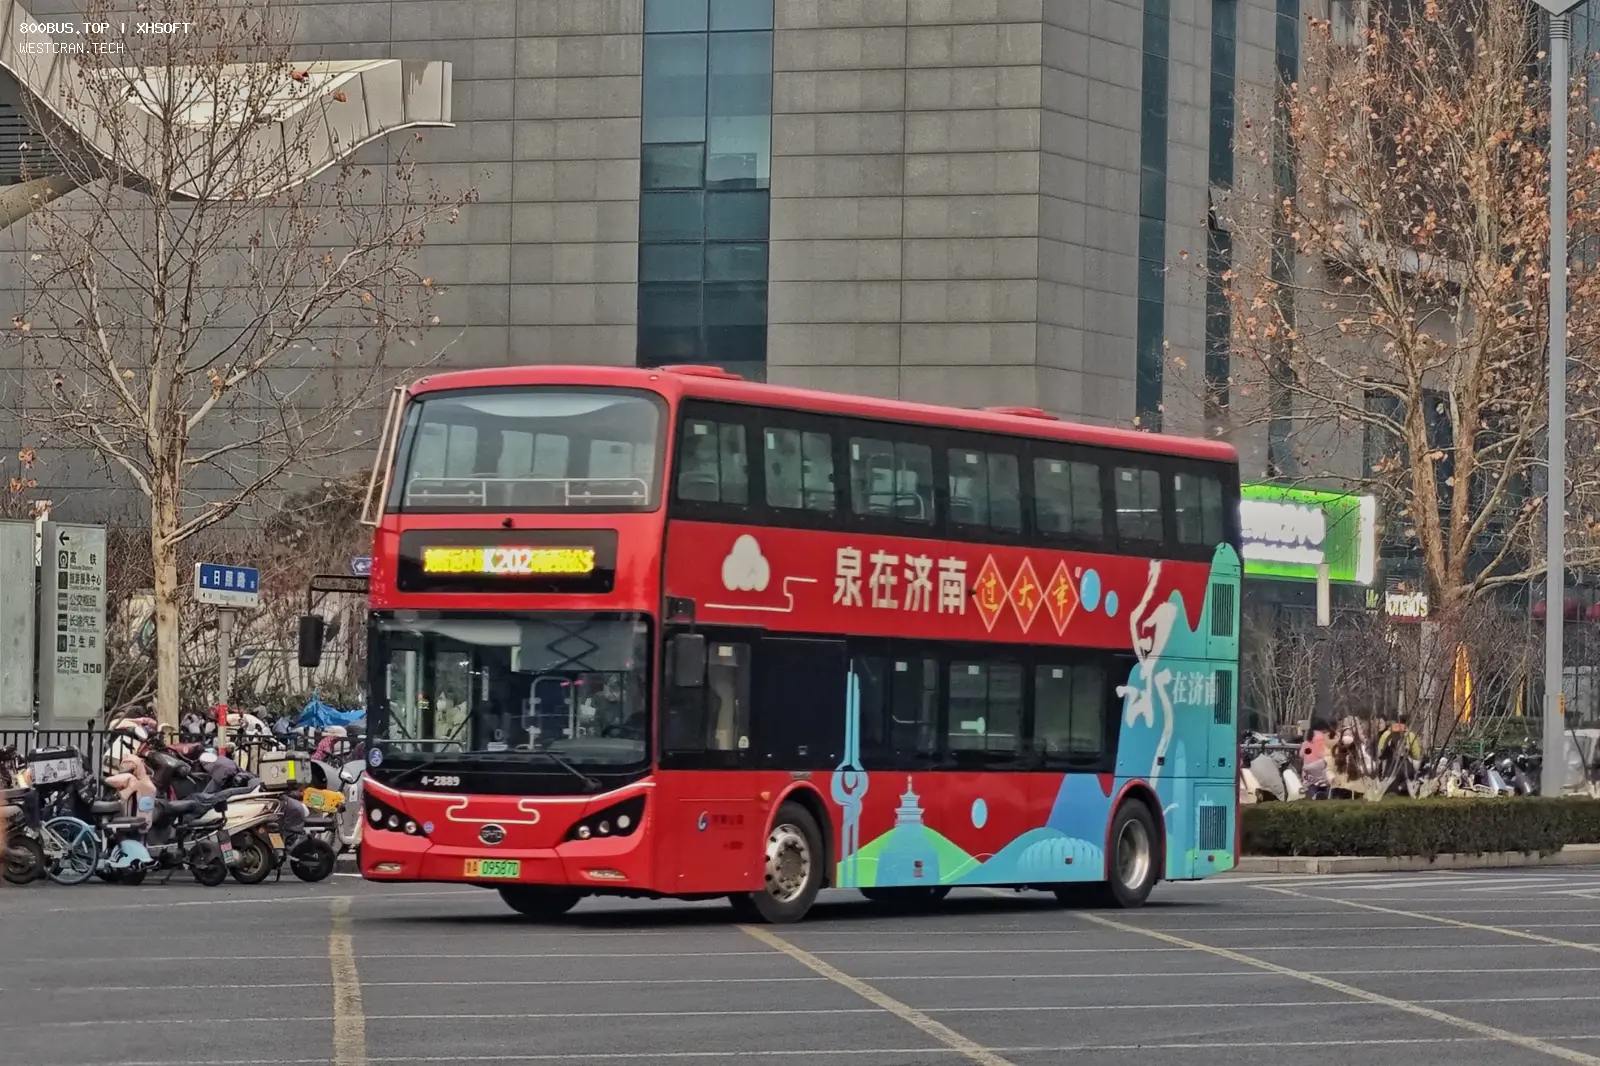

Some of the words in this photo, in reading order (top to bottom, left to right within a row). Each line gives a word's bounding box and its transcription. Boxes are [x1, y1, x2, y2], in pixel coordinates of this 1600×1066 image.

[484, 548, 532, 573] K202
[832, 546, 967, 615] 泉在济南
[420, 776, 460, 786] 4-2889
